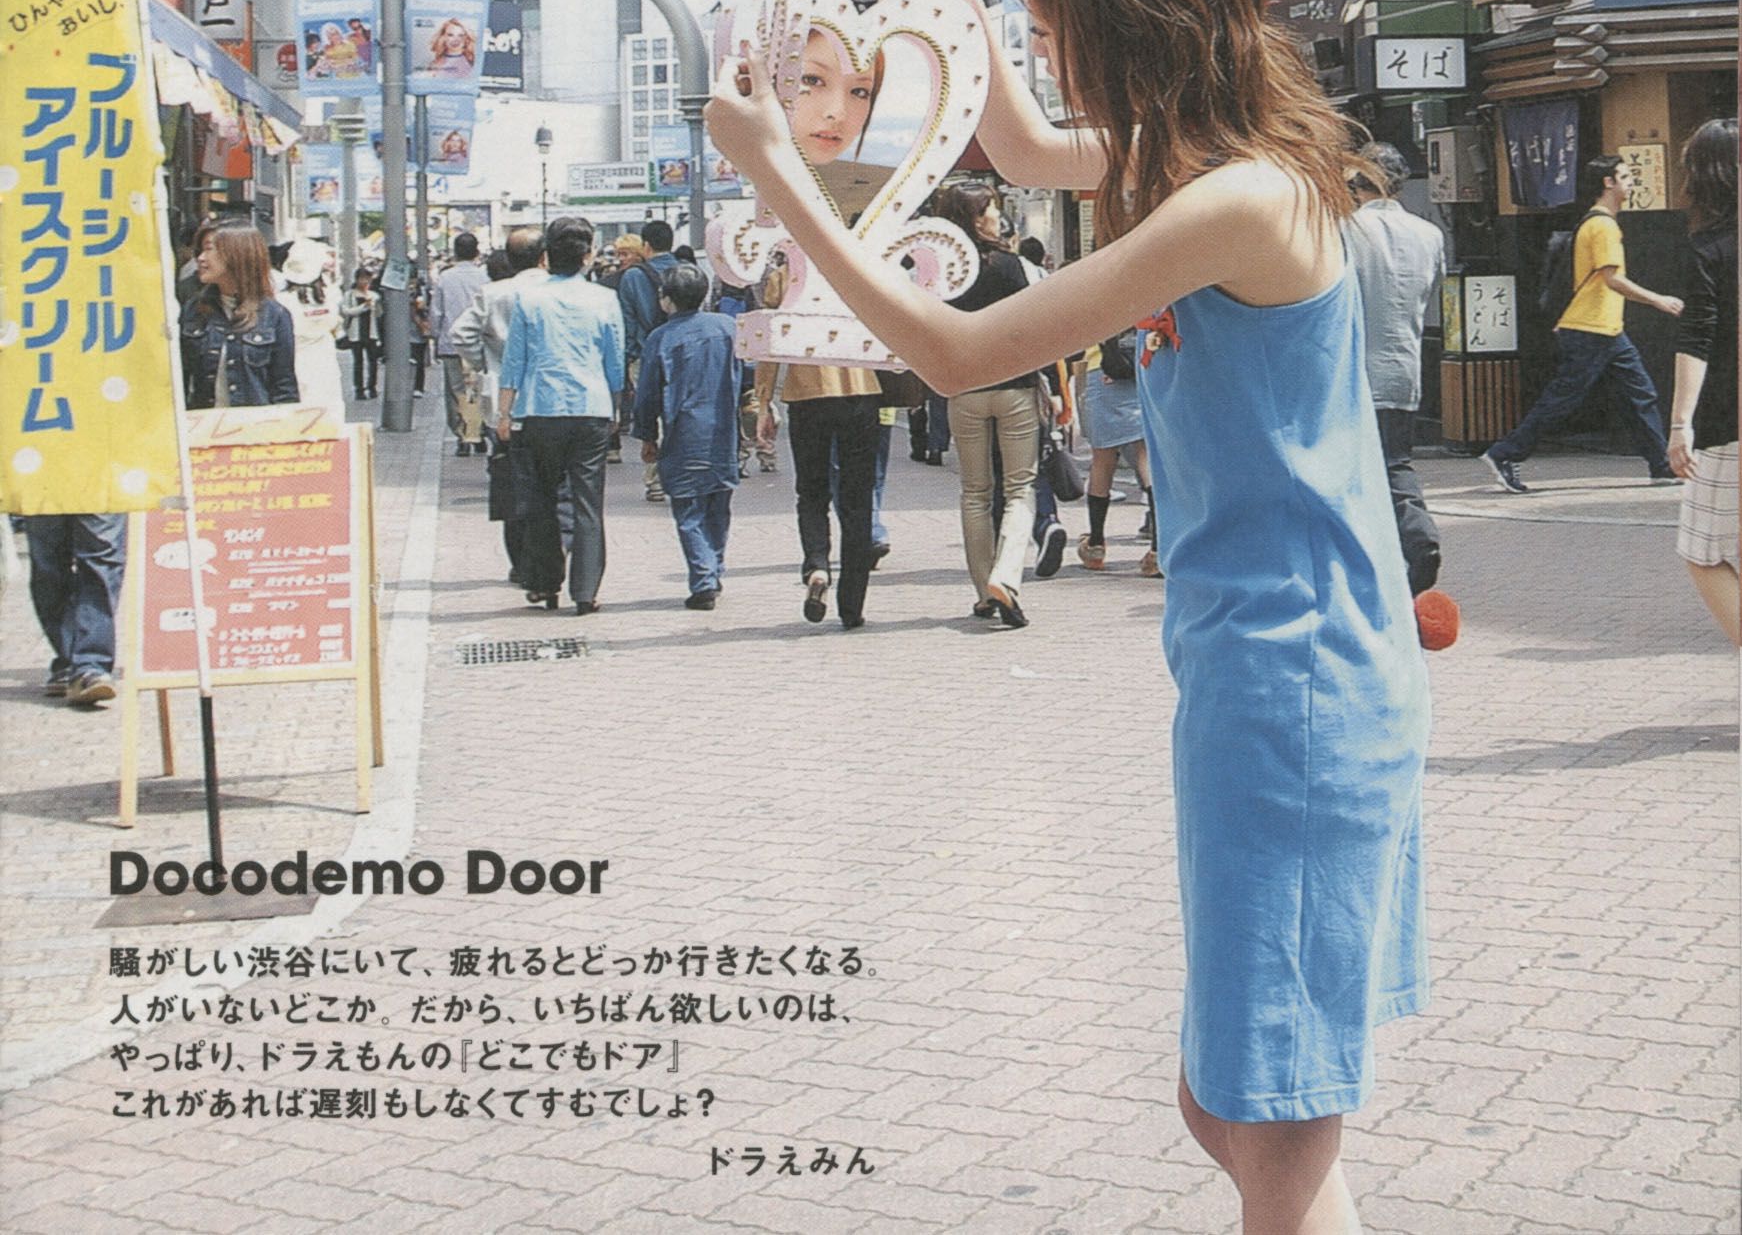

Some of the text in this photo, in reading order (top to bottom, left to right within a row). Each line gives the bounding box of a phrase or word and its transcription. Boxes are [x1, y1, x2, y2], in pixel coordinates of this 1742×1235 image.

[1385, 45, 1454, 80] そば
[81, 52, 136, 353] ブルーシール
[21, 87, 76, 432] アイスクリーム
[1470, 283, 1487, 346] うどん
[1493, 285, 1512, 327] そば
